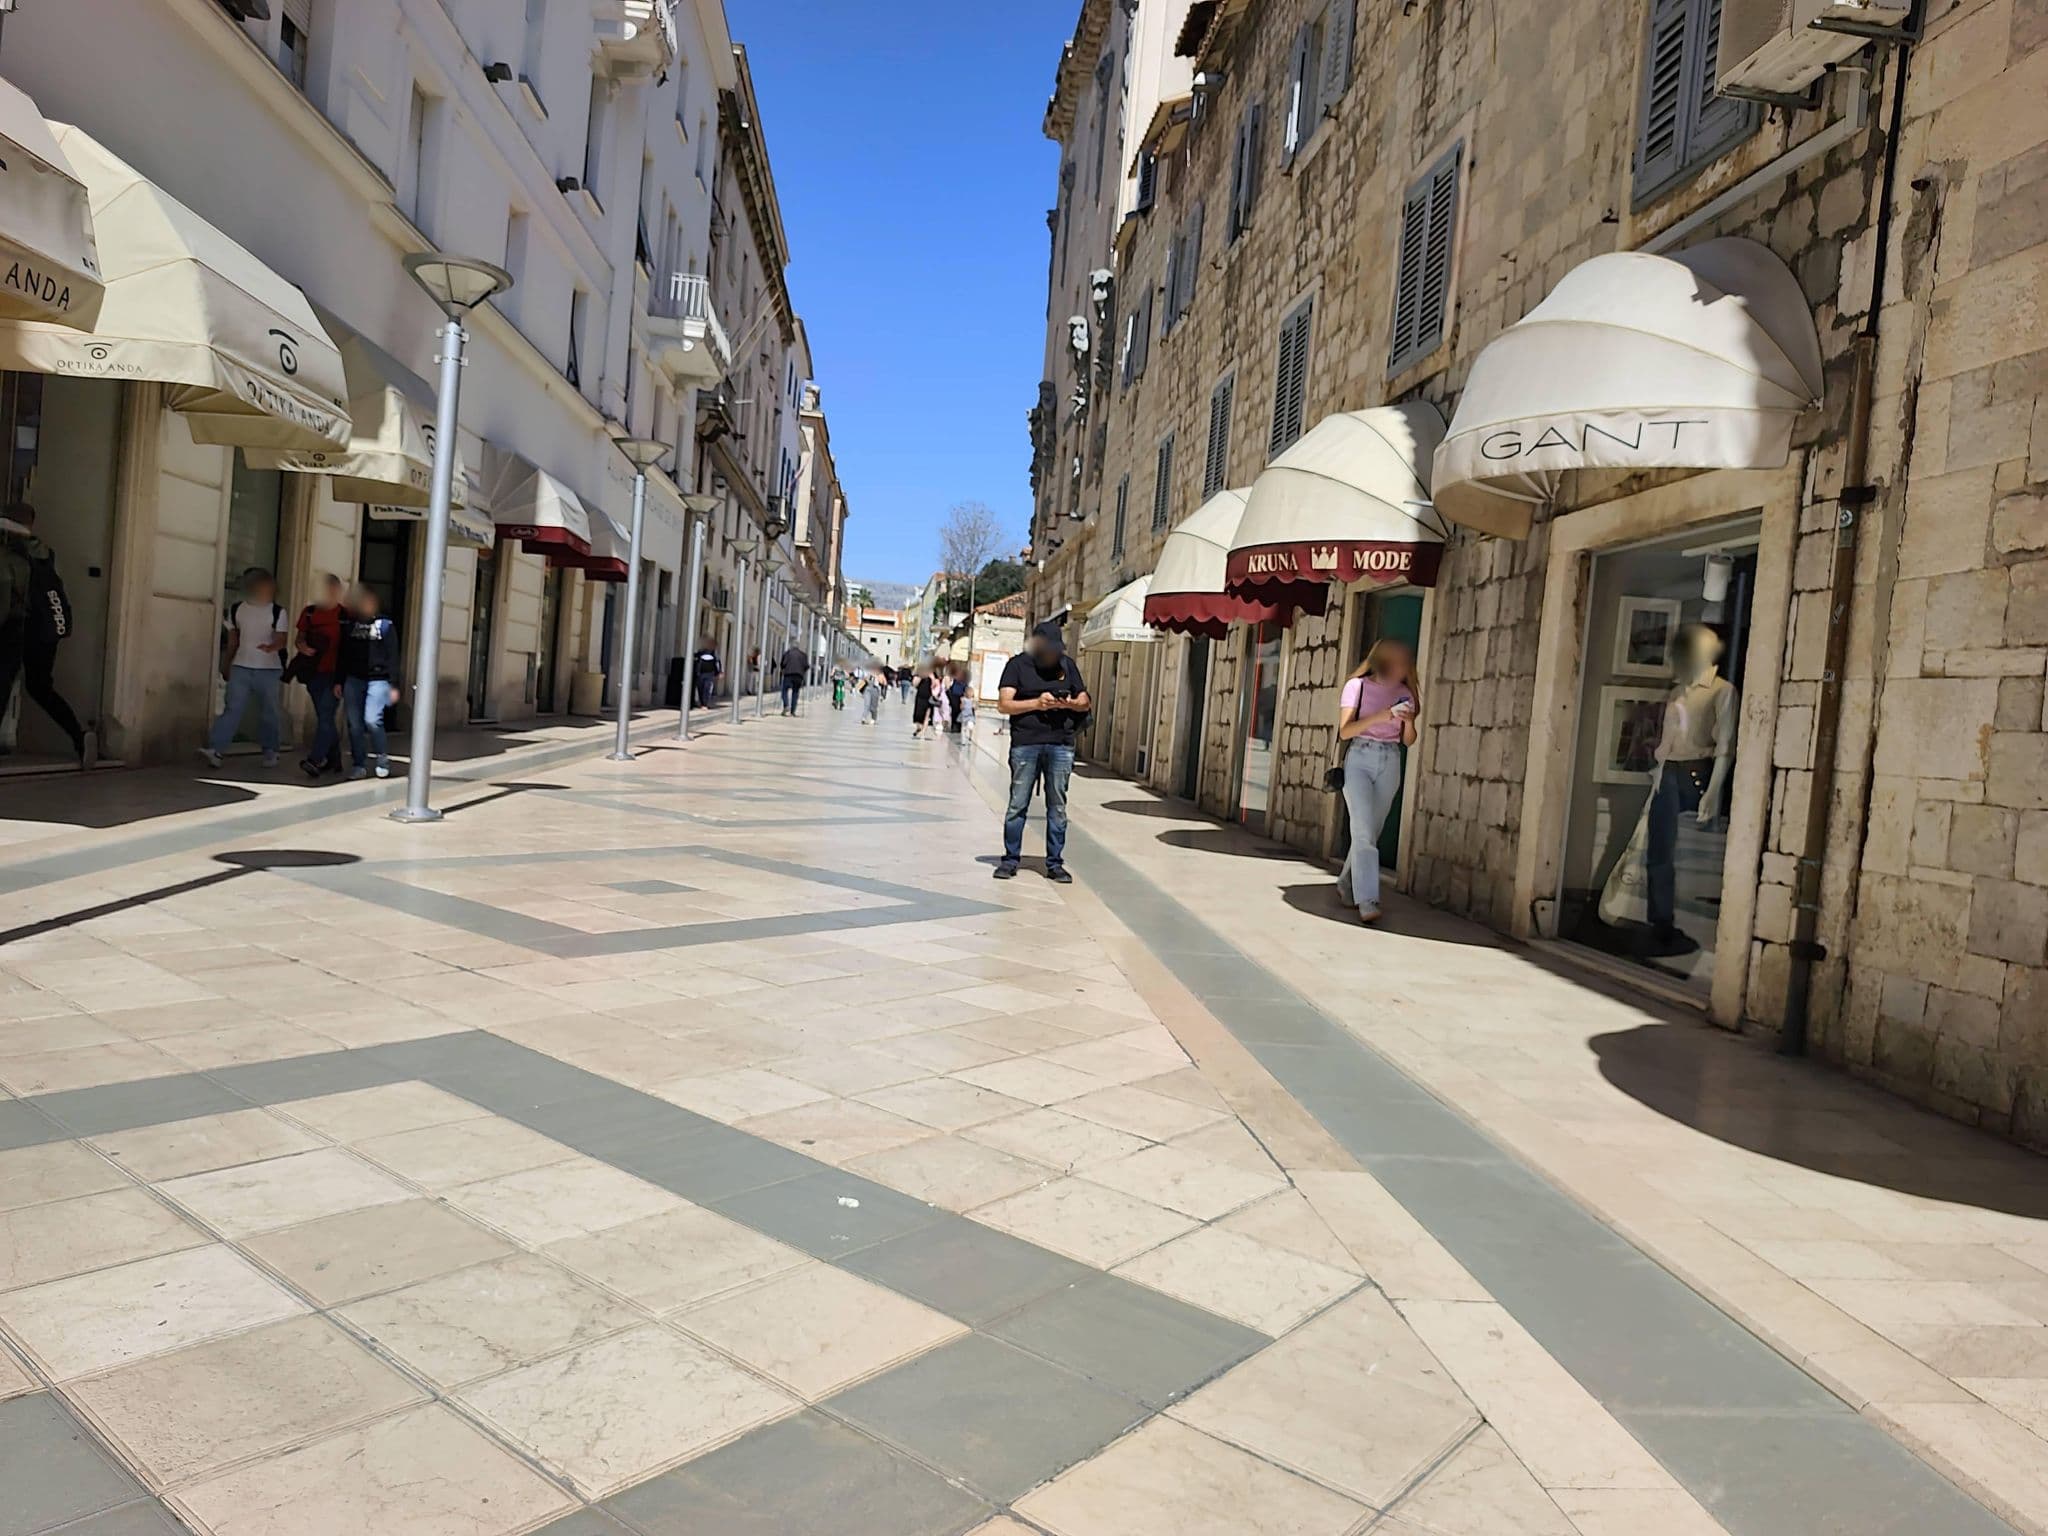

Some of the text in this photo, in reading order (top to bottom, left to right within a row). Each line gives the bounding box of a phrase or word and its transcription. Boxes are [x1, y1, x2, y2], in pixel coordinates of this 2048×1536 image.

[5, 262, 70, 311] ANDA
[57, 360, 143, 374] OPTIKA ANDA
[1481, 420, 1709, 460] GANT
[1247, 550, 1412, 573] KRUNA MODE
[47, 590, 66, 635] adidas
